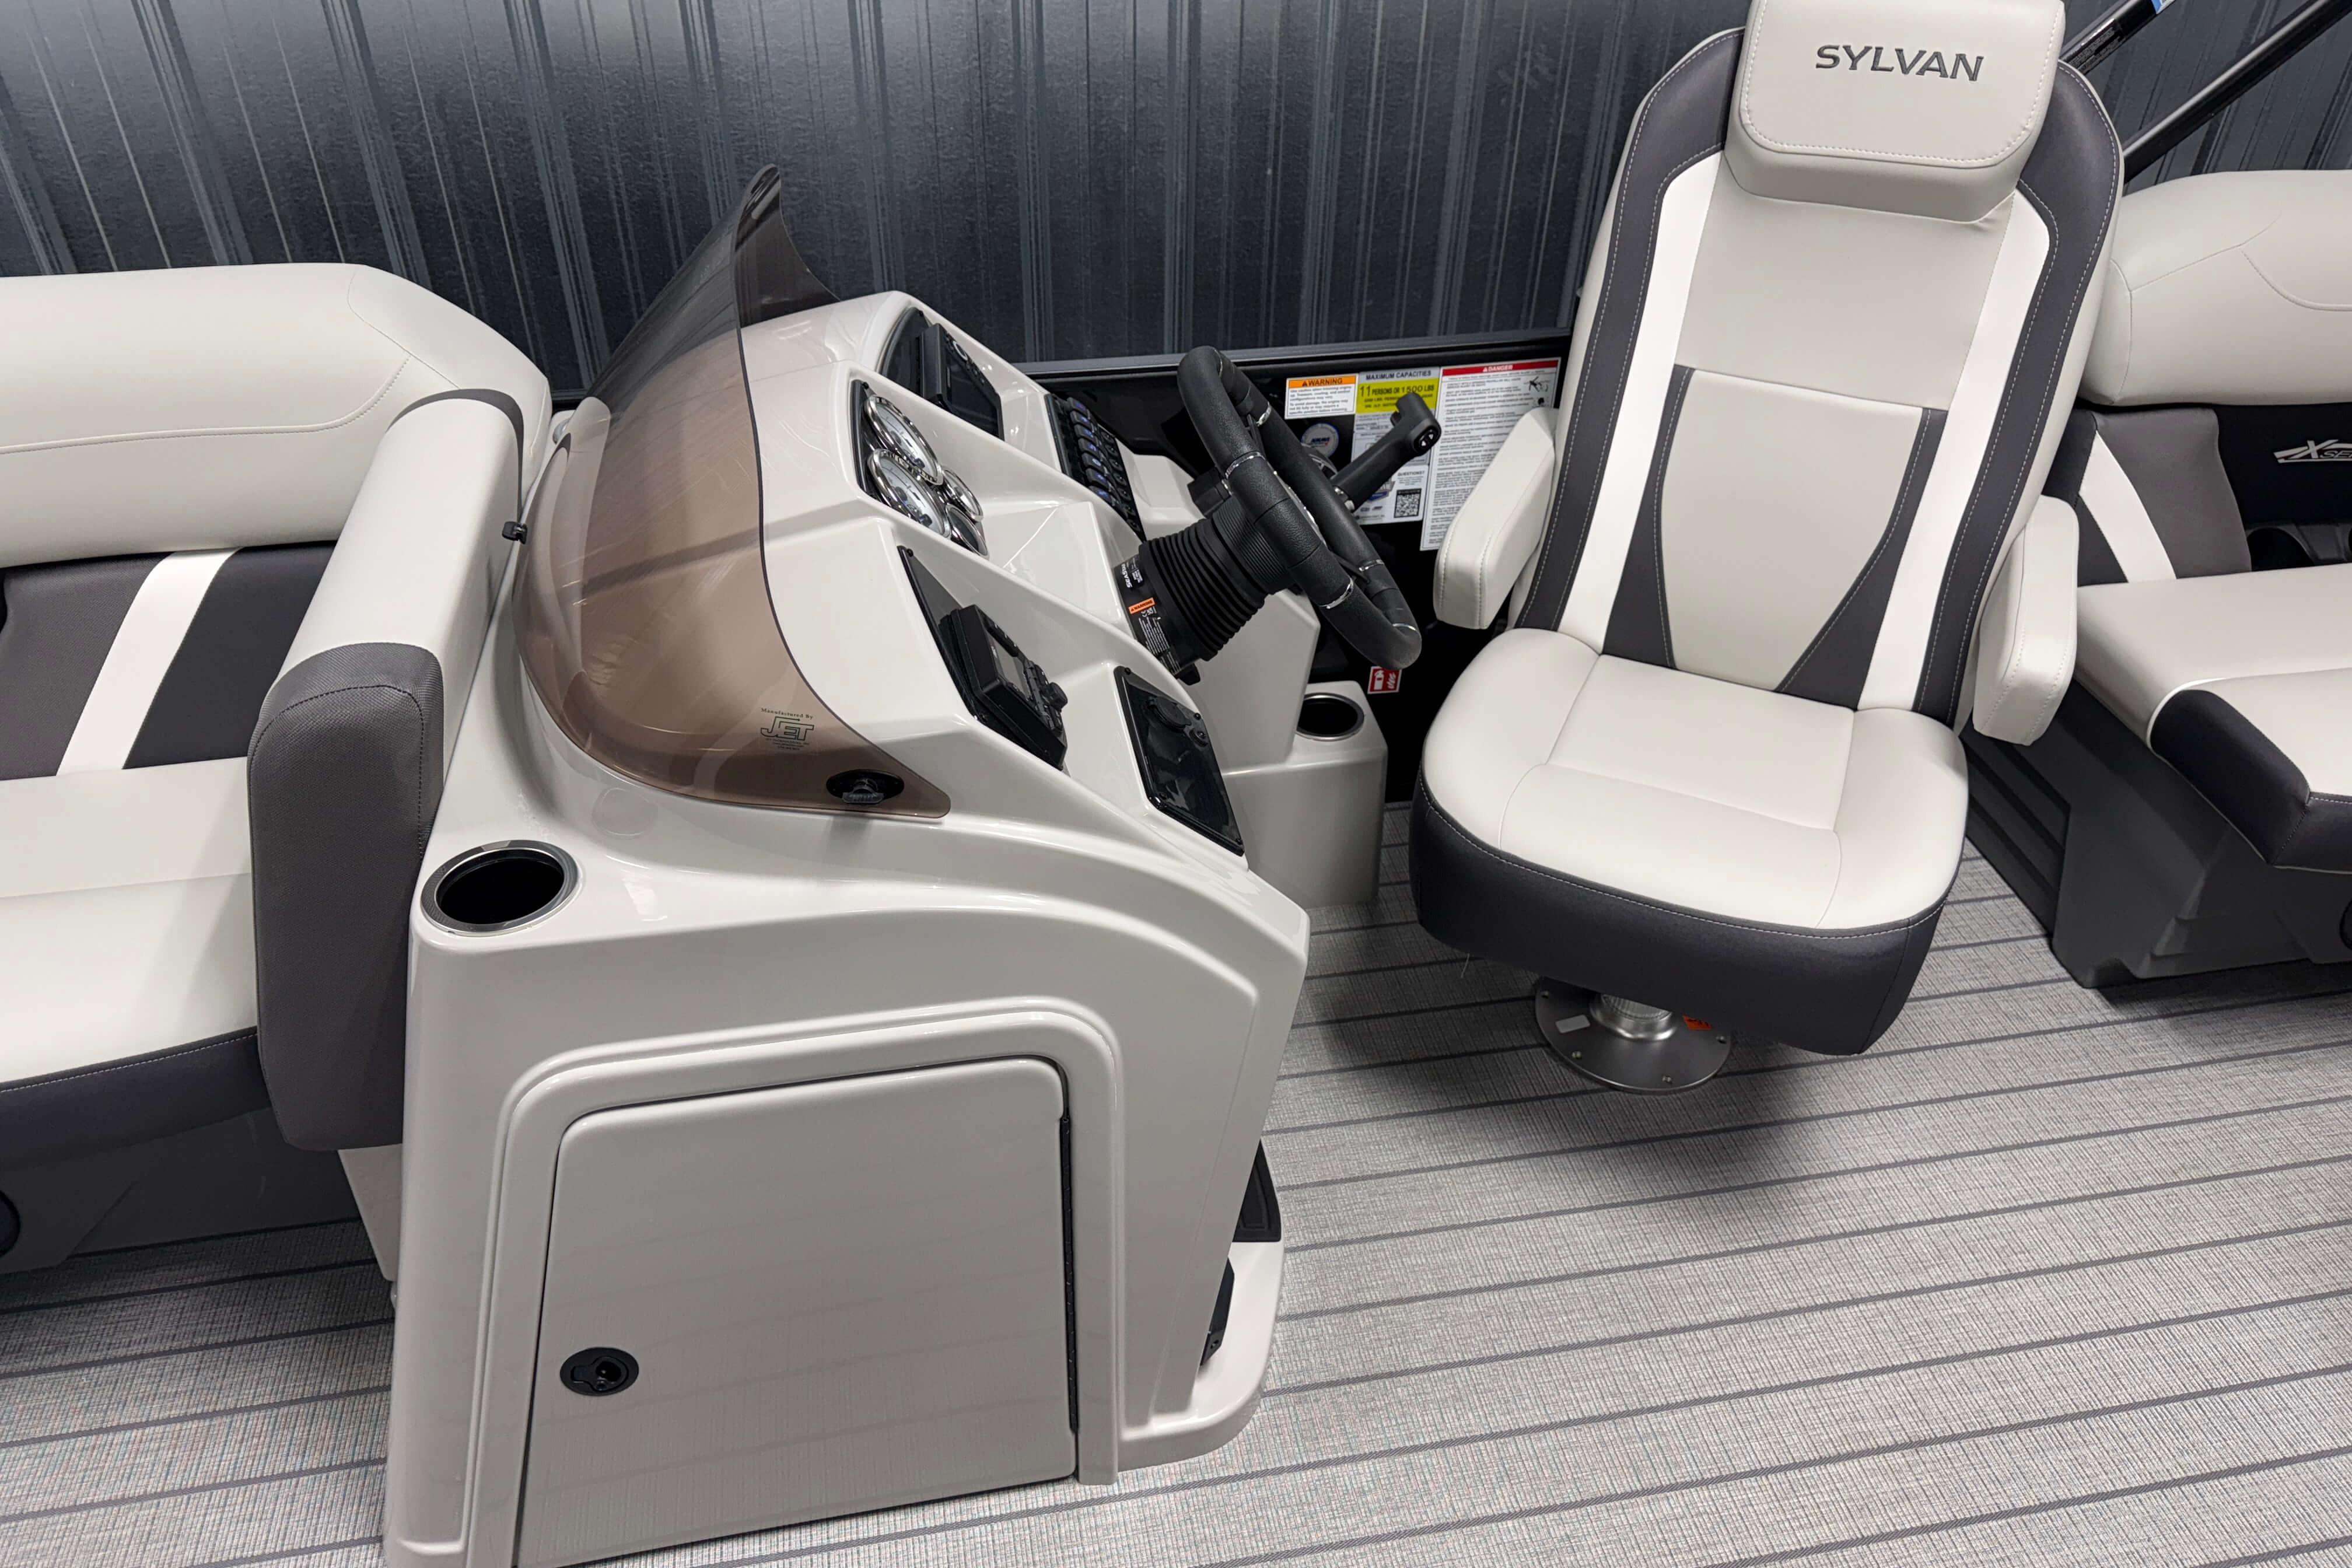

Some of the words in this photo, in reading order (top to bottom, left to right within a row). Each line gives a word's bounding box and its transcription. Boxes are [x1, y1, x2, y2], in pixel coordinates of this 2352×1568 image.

[1815, 44, 1985, 82] SYLVAN
[1396, 370, 1432, 379] CAPACITIES
[1308, 377, 1343, 386] WARNING
[1360, 385, 1371, 397] 11
[1372, 387, 1392, 395] PERSONS
[761, 708, 803, 718] Manufactured
[760, 716, 814, 741] JET
